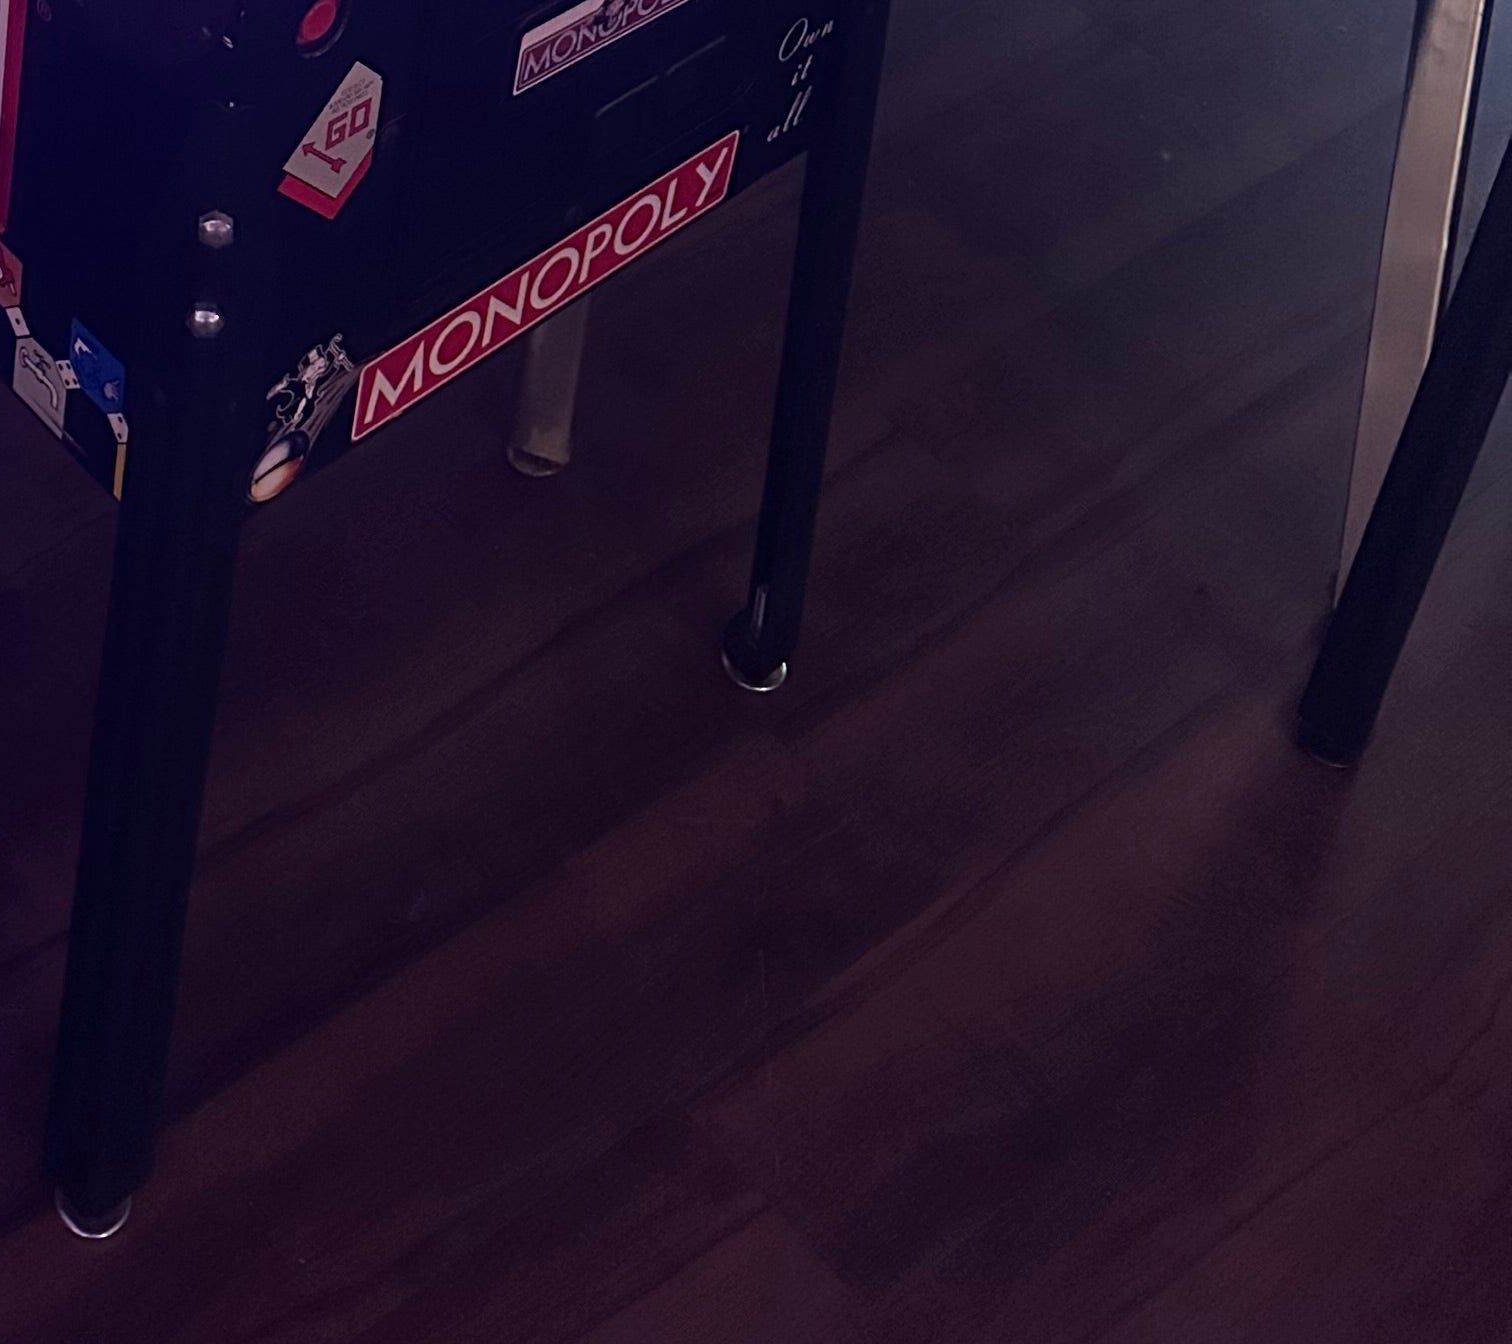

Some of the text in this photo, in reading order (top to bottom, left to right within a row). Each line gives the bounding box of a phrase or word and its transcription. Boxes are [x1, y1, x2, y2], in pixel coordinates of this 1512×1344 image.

[778, 17, 834, 62] Own
[791, 54, 813, 88] it
[325, 97, 372, 151] GO
[364, 146, 729, 425] MONOPOLY
